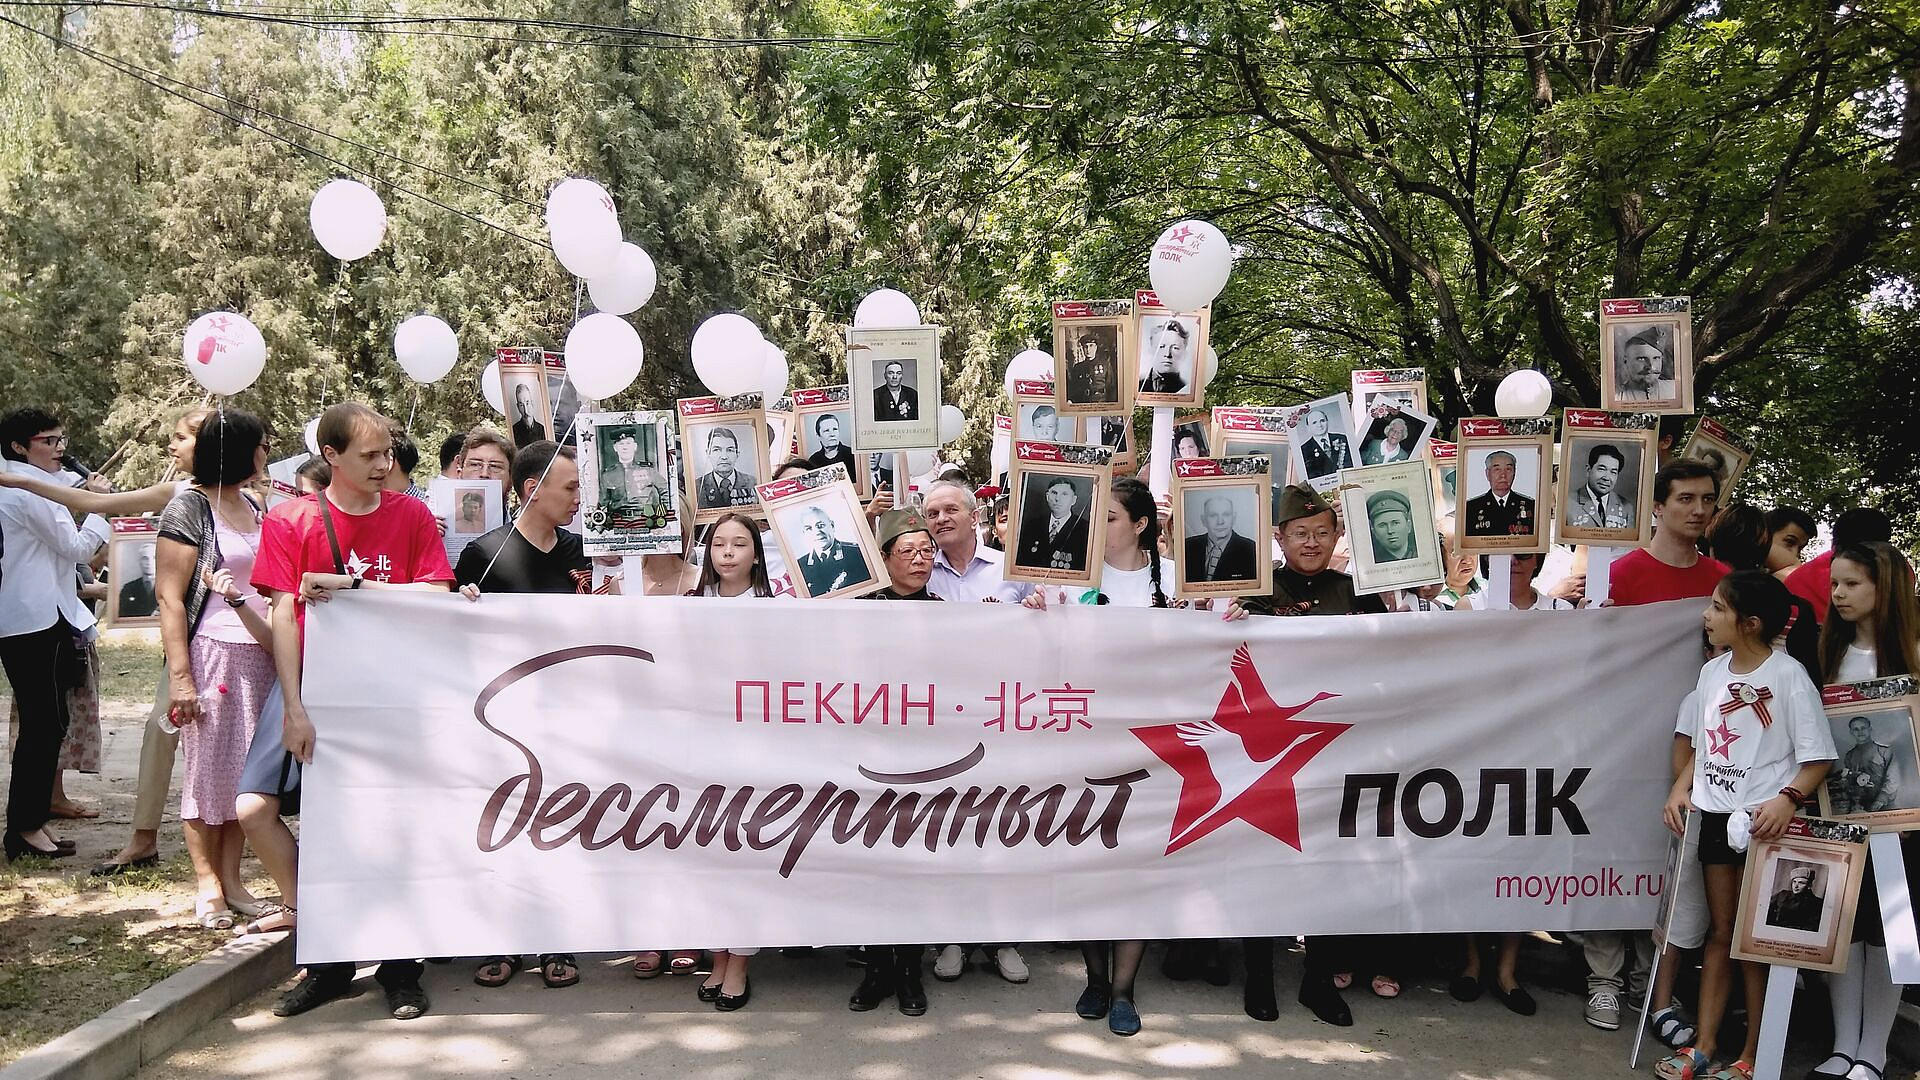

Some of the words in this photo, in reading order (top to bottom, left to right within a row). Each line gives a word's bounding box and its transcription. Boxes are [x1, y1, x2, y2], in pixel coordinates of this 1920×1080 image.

[735, 680, 937, 728] ПЕКИН
[983, 681, 1098, 734] 北京
[473, 644, 1151, 879] бессмертный
[1495, 867, 1664, 905] moypolk.ru
